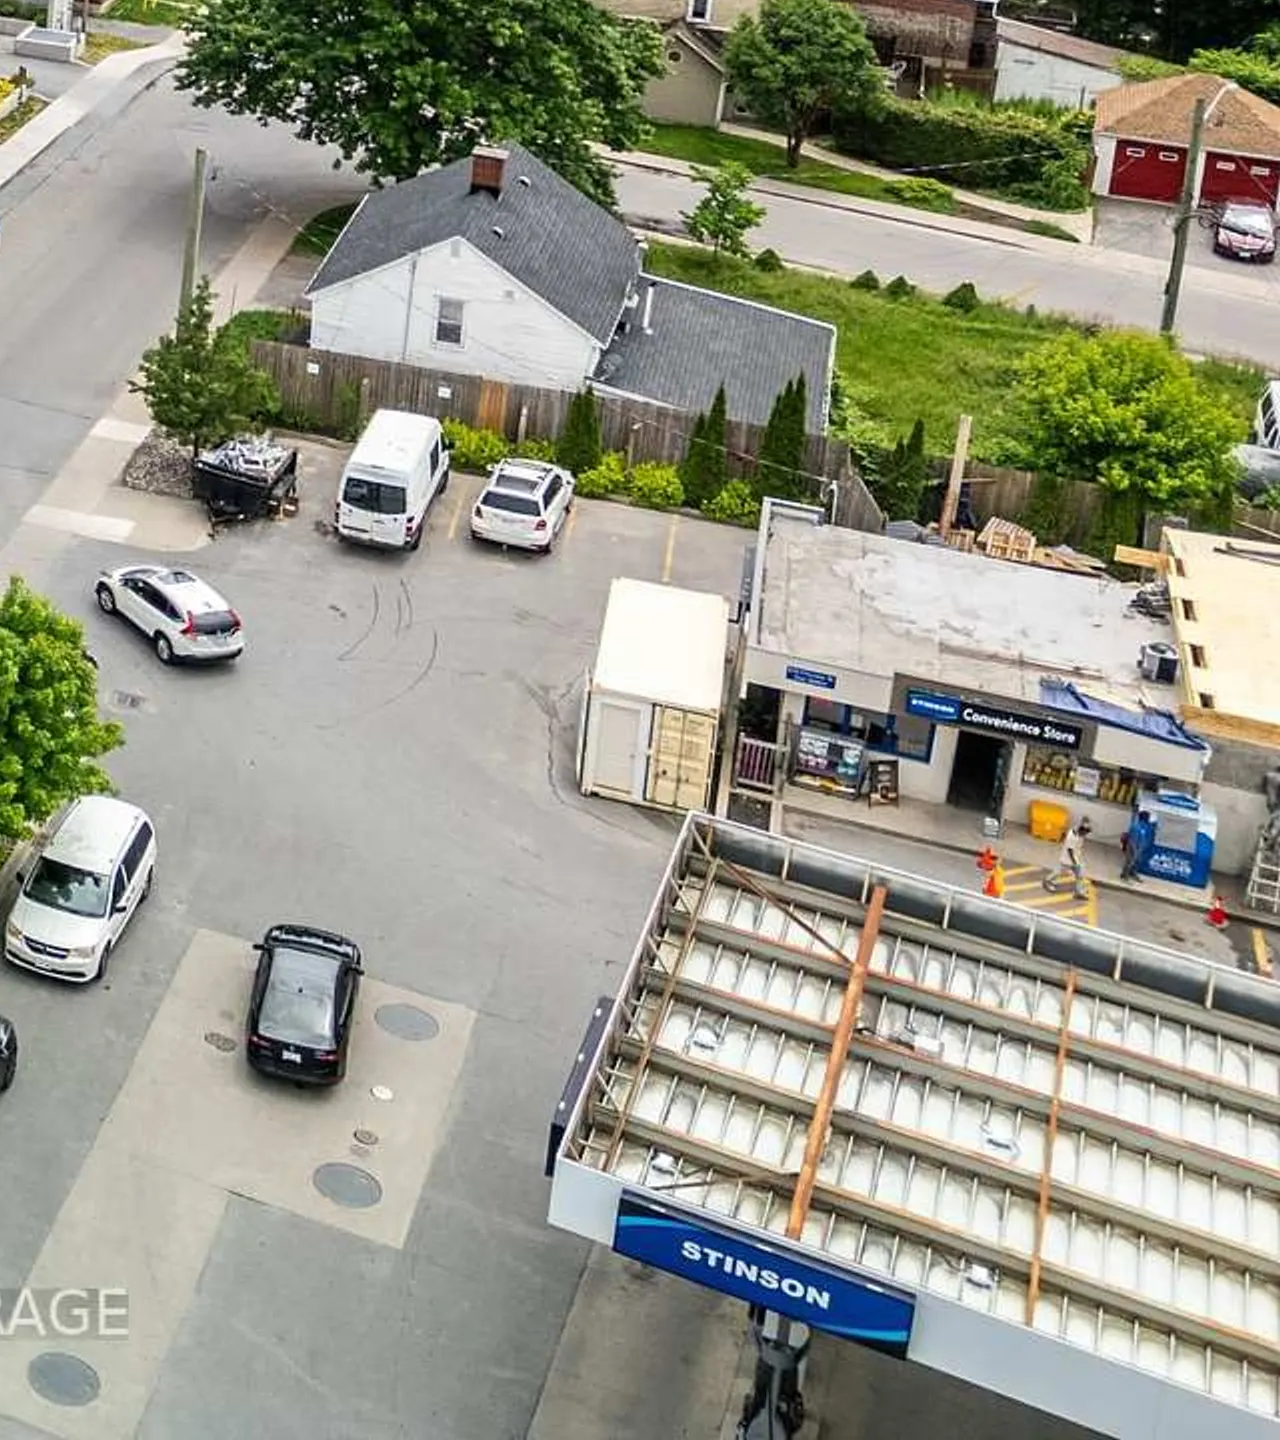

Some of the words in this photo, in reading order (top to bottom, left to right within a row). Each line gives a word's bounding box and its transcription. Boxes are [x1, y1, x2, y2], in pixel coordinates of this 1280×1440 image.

[962, 707, 1041, 736] Convenience
[1042, 725, 1077, 744] Store
[680, 1240, 831, 1310] STINSON
